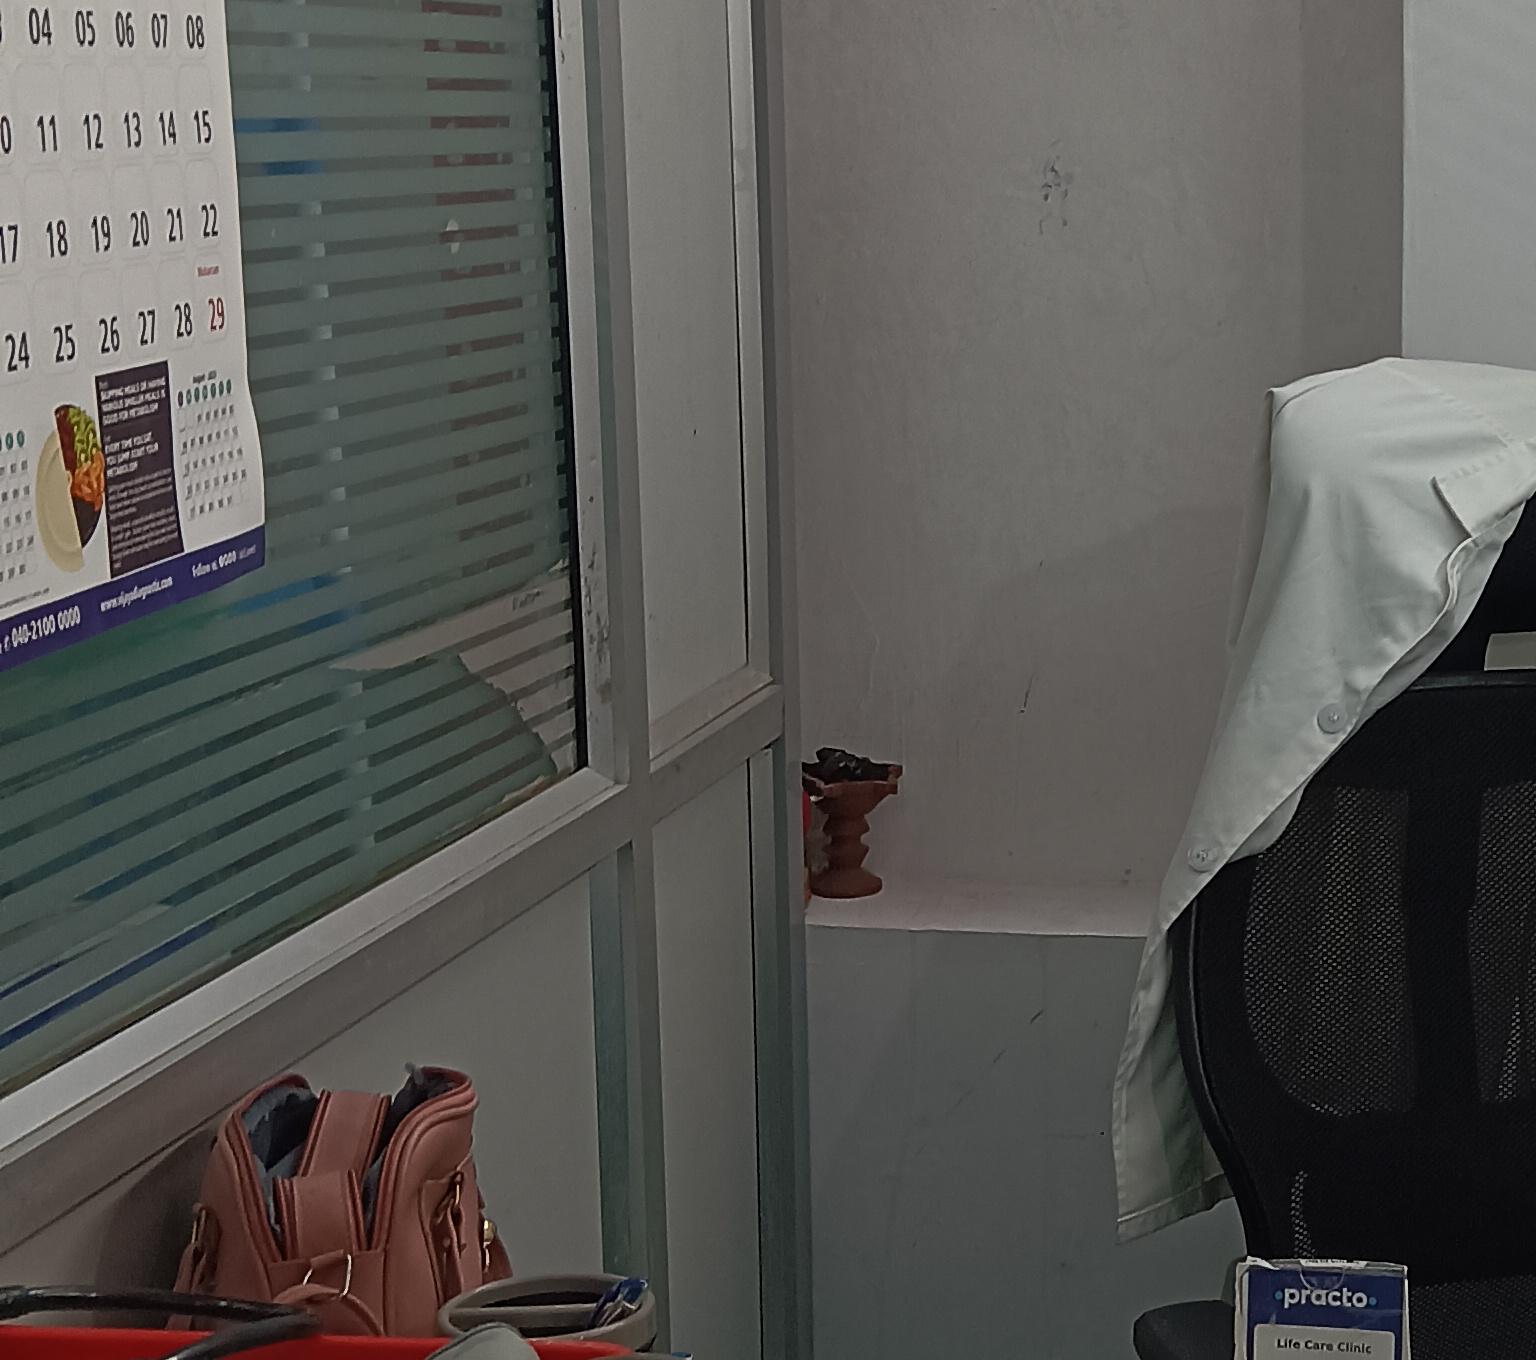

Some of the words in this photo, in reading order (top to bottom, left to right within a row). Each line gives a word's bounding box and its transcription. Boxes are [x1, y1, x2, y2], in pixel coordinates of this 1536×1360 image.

[29, 8, 52, 45] 04
[76, 10, 96, 47] 05
[116, 11, 135, 48] 06
[151, 13, 168, 48] 07
[186, 15, 205, 49] 08
[37, 115, 58, 152] 11
[83, 113, 103, 150] 12
[124, 112, 142, 148] 13
[159, 110, 177, 146] 14
[193, 110, 212, 144] 15
[0, 224, 18, 264] 17
[46, 219, 68, 258] 18
[91, 215, 111, 253] 19
[130, 211, 149, 248] 20
[167, 207, 184, 242] 21
[201, 203, 219, 238] 22
[6, 332, 31, 372] 24
[54, 324, 76, 363] 25
[100, 316, 120, 354] 26
[138, 309, 156, 346] 27
[175, 302, 193, 339] 28
[208, 297, 225, 332] 29
[1284, 1286, 1368, 1311] practo
[1276, 1337, 1300, 1350] Life
[1304, 1339, 1334, 1352] Care
[1337, 1341, 1372, 1355] Clinic
